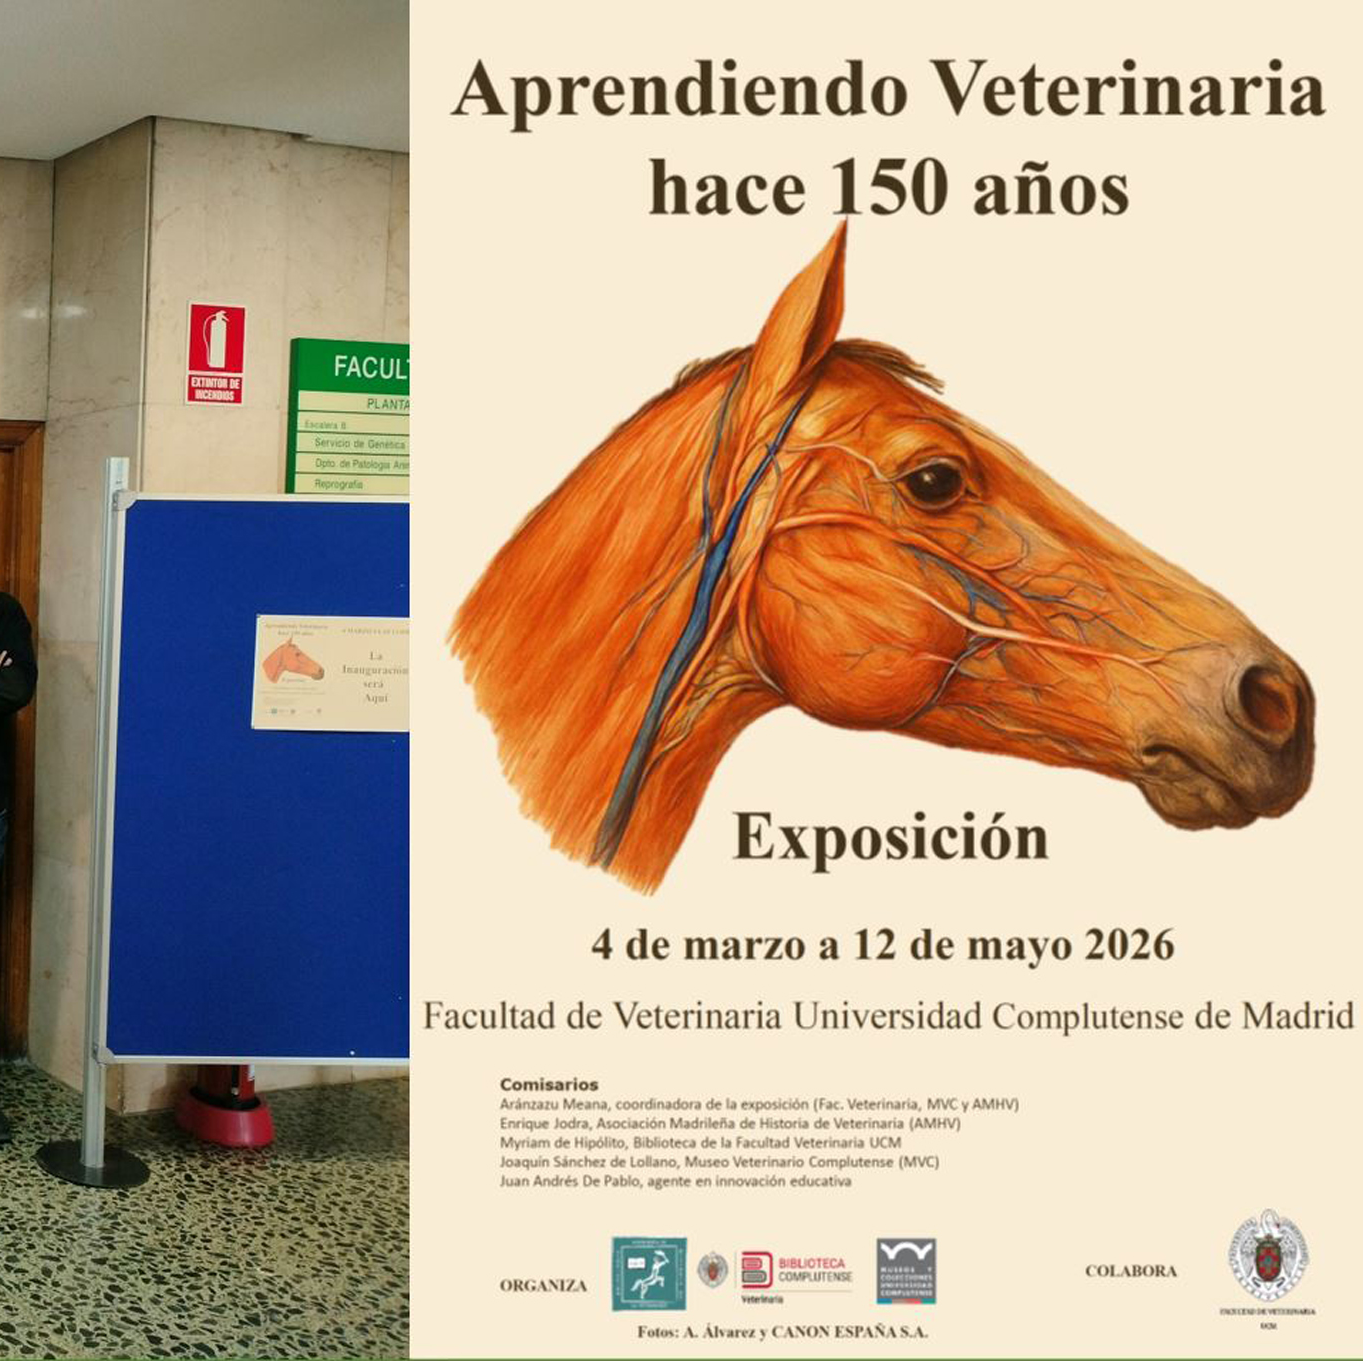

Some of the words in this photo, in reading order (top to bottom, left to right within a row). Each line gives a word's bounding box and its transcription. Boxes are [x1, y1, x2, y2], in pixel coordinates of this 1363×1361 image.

[449, 58, 908, 134] Aprendiendo
[928, 58, 1327, 117] Veterinaria
[648, 158, 806, 216] hace
[832, 156, 948, 216] 150
[973, 160, 1129, 216] años
[334, 355, 410, 380] FACUL
[191, 376, 228, 388] EXTINTOR
[229, 378, 240, 389] DE
[194, 389, 235, 401] INCENDIOS
[314, 437, 350, 448] Servicio
[353, 438, 365, 448] de
[339, 459, 351, 468] de
[732, 810, 1049, 874] Exposición
[591, 927, 613, 960] 4
[625, 928, 670, 961] de
[683, 936, 806, 961] marzo
[819, 936, 840, 961] a
[854, 927, 896, 960] 12
[910, 928, 955, 961] de
[967, 936, 1072, 970] mayo
[1085, 927, 1175, 961] 2026
[423, 1000, 556, 1030] Facultad
[566, 1000, 603, 1030] de
[612, 1000, 782, 1030] Veterinaria
[793, 1000, 982, 1030] Universidad
[992, 1002, 1184, 1037] Complutense
[1195, 1000, 1231, 1030] de
[1242, 1000, 1355, 1030] Madrid
[500, 1076, 599, 1092] Comisarios
[499, 1097, 559, 1111] Aránzazu
[562, 1097, 612, 1113] Meana,
[614, 1097, 702, 1111] coordinadora
[705, 1097, 723, 1111] de
[725, 1097, 738, 1111] la
[740, 1097, 810, 1114] exposición
[813, 1097, 845, 1113] (Fac.
[846, 1097, 922, 1113] Veterinaria,
[926, 1097, 958, 1111] MVC
[961, 1100, 970, 1114] y
[971, 1097, 1020, 1113] AMHV)
[499, 1116, 550, 1133] Enrique
[553, 1116, 593, 1132] Jodra,
[595, 1116, 667, 1130] Asociación
[669, 1116, 736, 1130] Madrileña
[738, 1116, 757, 1130] de
[759, 1117, 810, 1130] Historia
[813, 1116, 831, 1130] de
[832, 1117, 905, 1130] Veterinaria
[908, 1116, 962, 1133] (AMHV)
[499, 1135, 551, 1152] Myriam
[553, 1136, 571, 1150] de
[574, 1135, 629, 1152] Hipólito,
[633, 1135, 697, 1150] Biblioteca
[700, 1136, 718, 1150] de
[720, 1136, 733, 1149] la
[735, 1135, 791, 1150] Facultad
[793, 1136, 865, 1150] Veterinaria
[869, 1135, 902, 1150] UCM
[499, 1155, 551, 1171] Joaquín
[552, 1155, 607, 1169] Sánchez
[609, 1154, 627, 1169] de
[629, 1154, 681, 1170] Lollano,
[684, 1155, 730, 1169] Museo
[732, 1155, 805, 1169] Veterinario
[808, 1155, 895, 1171] Complutense
[898, 1155, 940, 1171] (MVC)
[499, 1174, 530, 1188] Juan
[532, 1174, 579, 1188] Andrés
[582, 1173, 601, 1188] De
[603, 1174, 644, 1190] Pablo,
[646, 1176, 692, 1191] agente
[695, 1177, 713, 1188] en
[715, 1174, 787, 1188] innovación
[789, 1174, 853, 1188] educativa
[778, 1257, 846, 1269] BIBLIOTECA
[1085, 1264, 1177, 1278] COLABORA
[778, 1271, 853, 1283] COMPLUTENSE
[500, 1279, 587, 1293] ORGANIZA
[741, 1294, 784, 1305] Veterinaria
[637, 1324, 680, 1339] Fotos:
[682, 1325, 699, 1339] A.
[702, 1322, 756, 1339] Álvarez
[759, 1328, 768, 1343] y
[771, 1324, 830, 1339] CANON
[834, 1321, 898, 1340] ESPAÑA
[899, 1324, 930, 1340] S.A.
